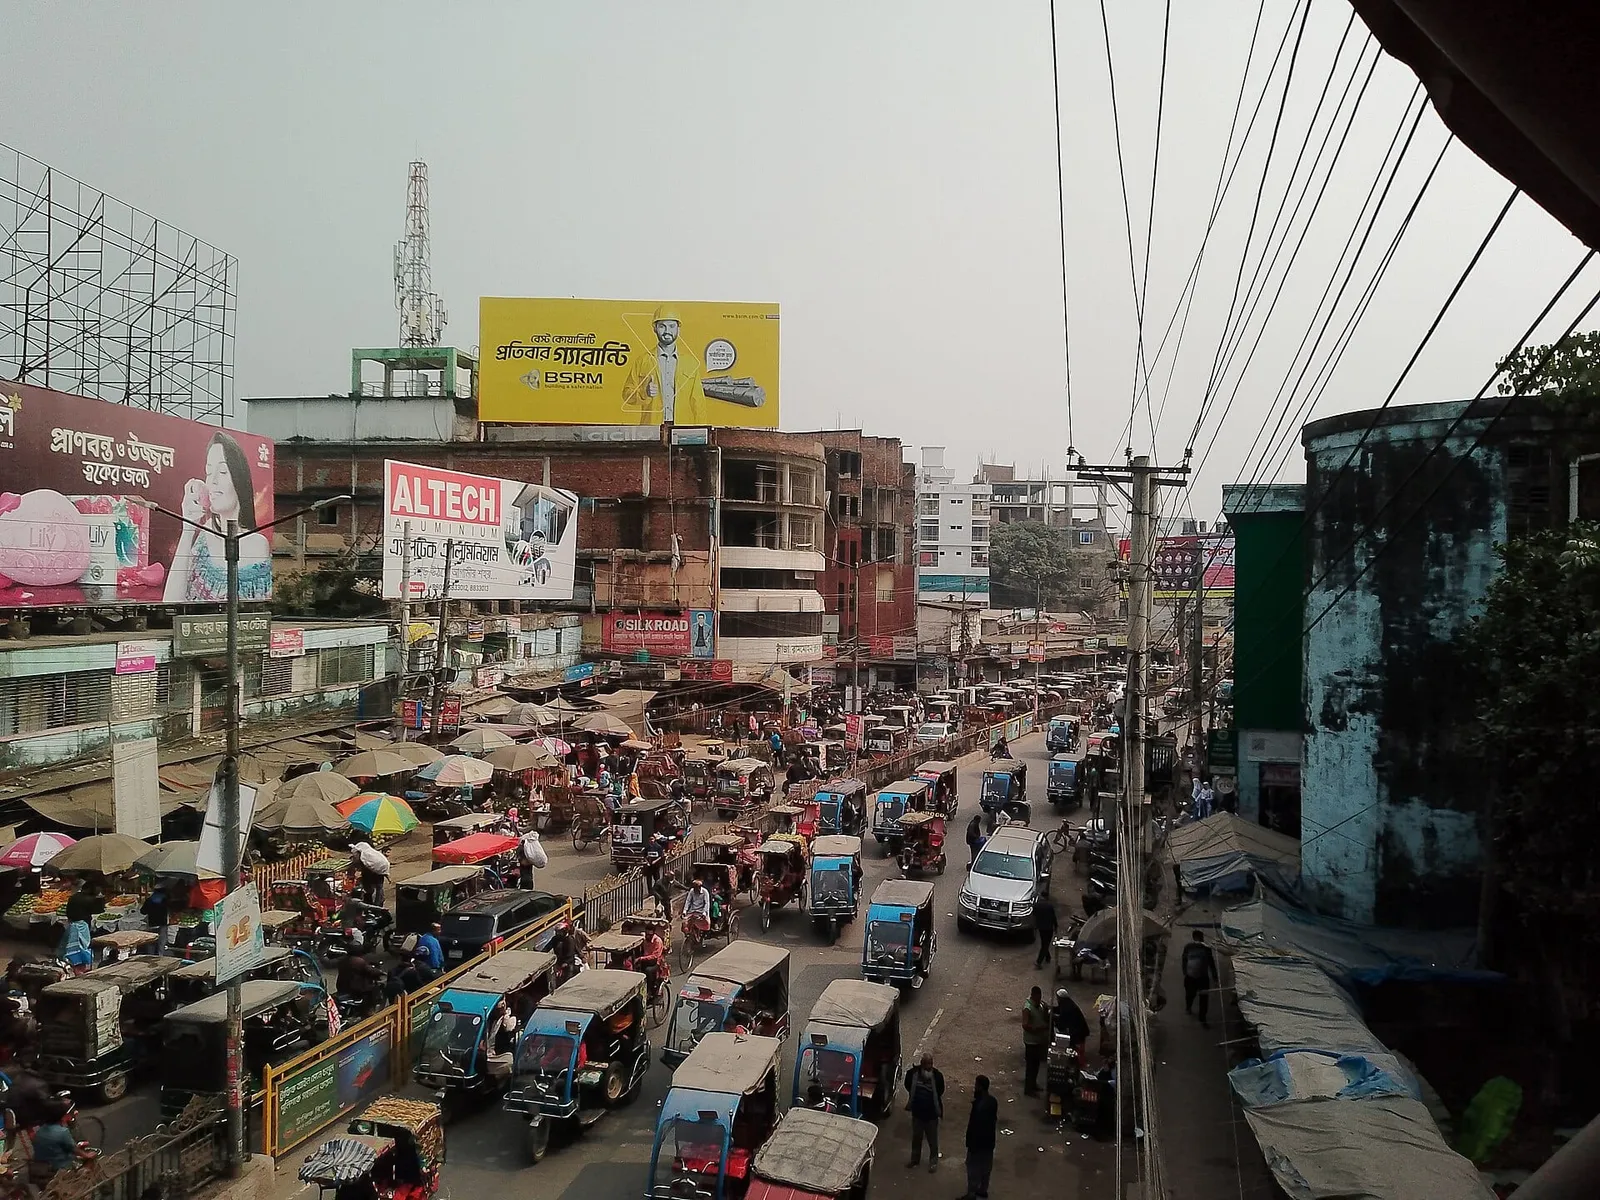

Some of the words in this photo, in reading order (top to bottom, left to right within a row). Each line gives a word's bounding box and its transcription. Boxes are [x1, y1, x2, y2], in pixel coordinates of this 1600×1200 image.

[531, 333, 551, 344] বেস্ট
[496, 341, 552, 361] প্রতিবার
[553, 340, 630, 367] গ্যারান্টি
[545, 372, 602, 384] BSRM
[50, 426, 114, 462] প্রাণবন্ত
[116, 443, 126, 458] ও
[126, 432, 175, 474] উজ্জ্বল
[82, 460, 120, 486] ত্বকের
[122, 464, 151, 489] জন্য
[392, 474, 496, 522] ALTECH
[30, 526, 56, 551] Lily
[88, 525, 109, 547] Lily
[394, 518, 499, 537] AUMINIUM
